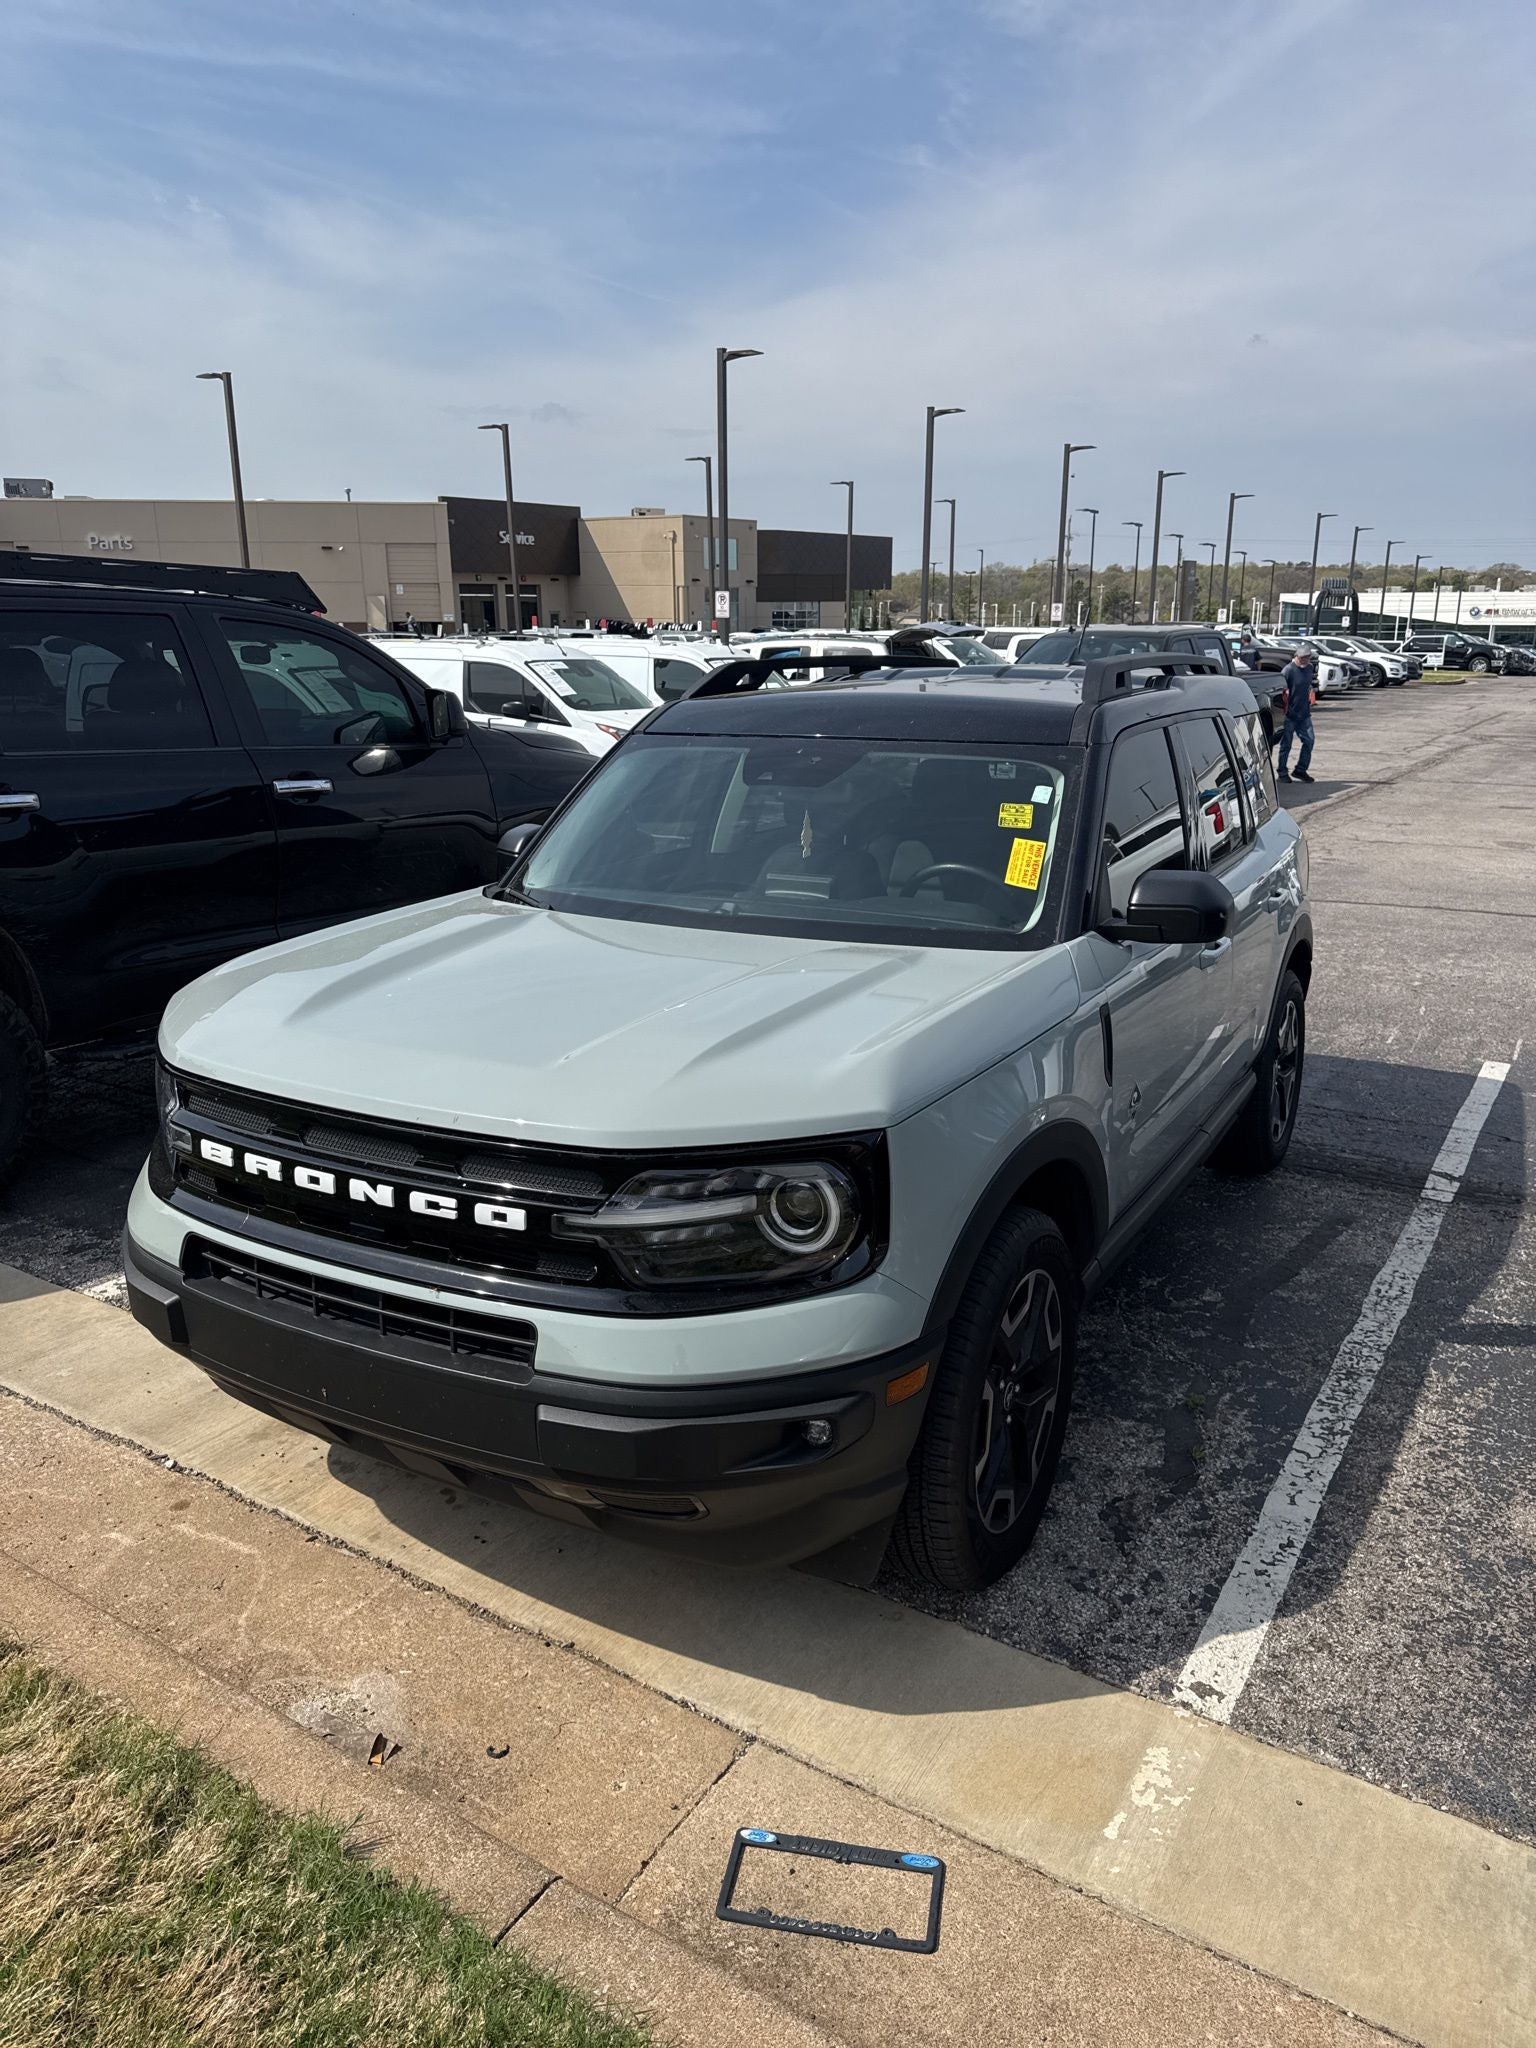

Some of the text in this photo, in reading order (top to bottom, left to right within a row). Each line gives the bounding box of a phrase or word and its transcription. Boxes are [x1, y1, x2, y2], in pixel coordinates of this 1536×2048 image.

[87, 533, 133, 550] Parts
[499, 530, 535, 546] Sevice
[1501, 608, 1520, 616] BMW
[1025, 857, 1033, 868] FOR
[1028, 844, 1044, 888] THIS VEHICLE
[1021, 869, 1030, 884] SALE
[200, 1138, 527, 1231] BRONCO
